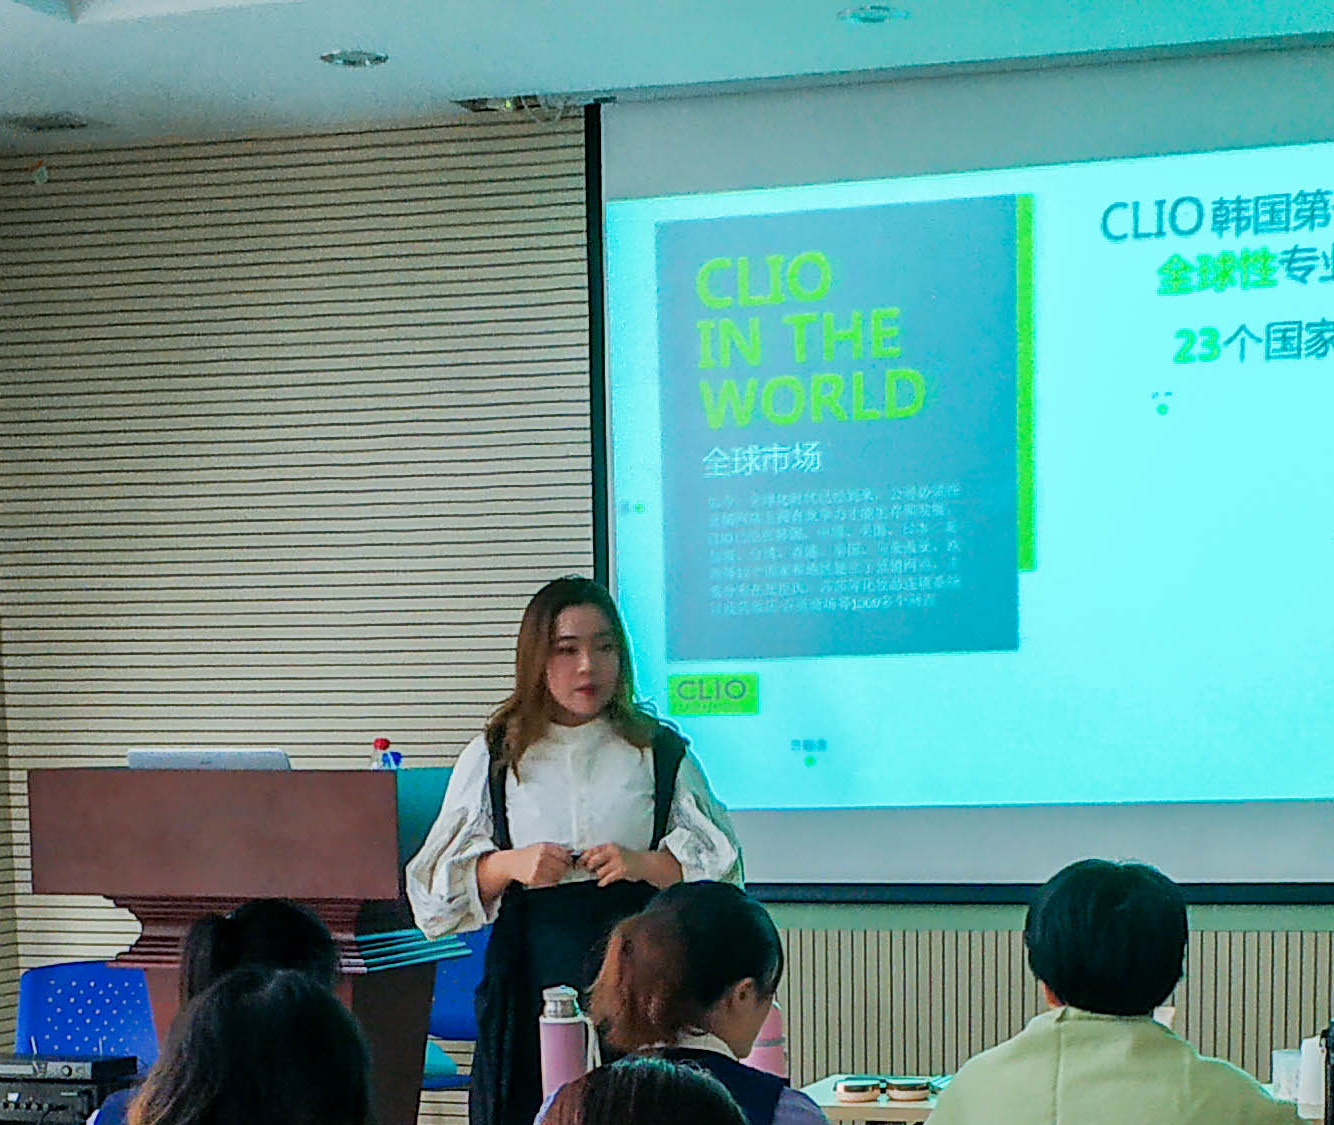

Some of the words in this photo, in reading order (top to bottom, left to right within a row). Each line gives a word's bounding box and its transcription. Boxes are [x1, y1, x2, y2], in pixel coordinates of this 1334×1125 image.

[1101, 197, 1204, 242] CLIO
[696, 251, 831, 308] CLIO
[697, 316, 761, 369] IN
[782, 308, 902, 364] THE
[699, 369, 926, 429] WORLD
[702, 442, 821, 479] 全球市场
[677, 679, 747, 701] CLIO
